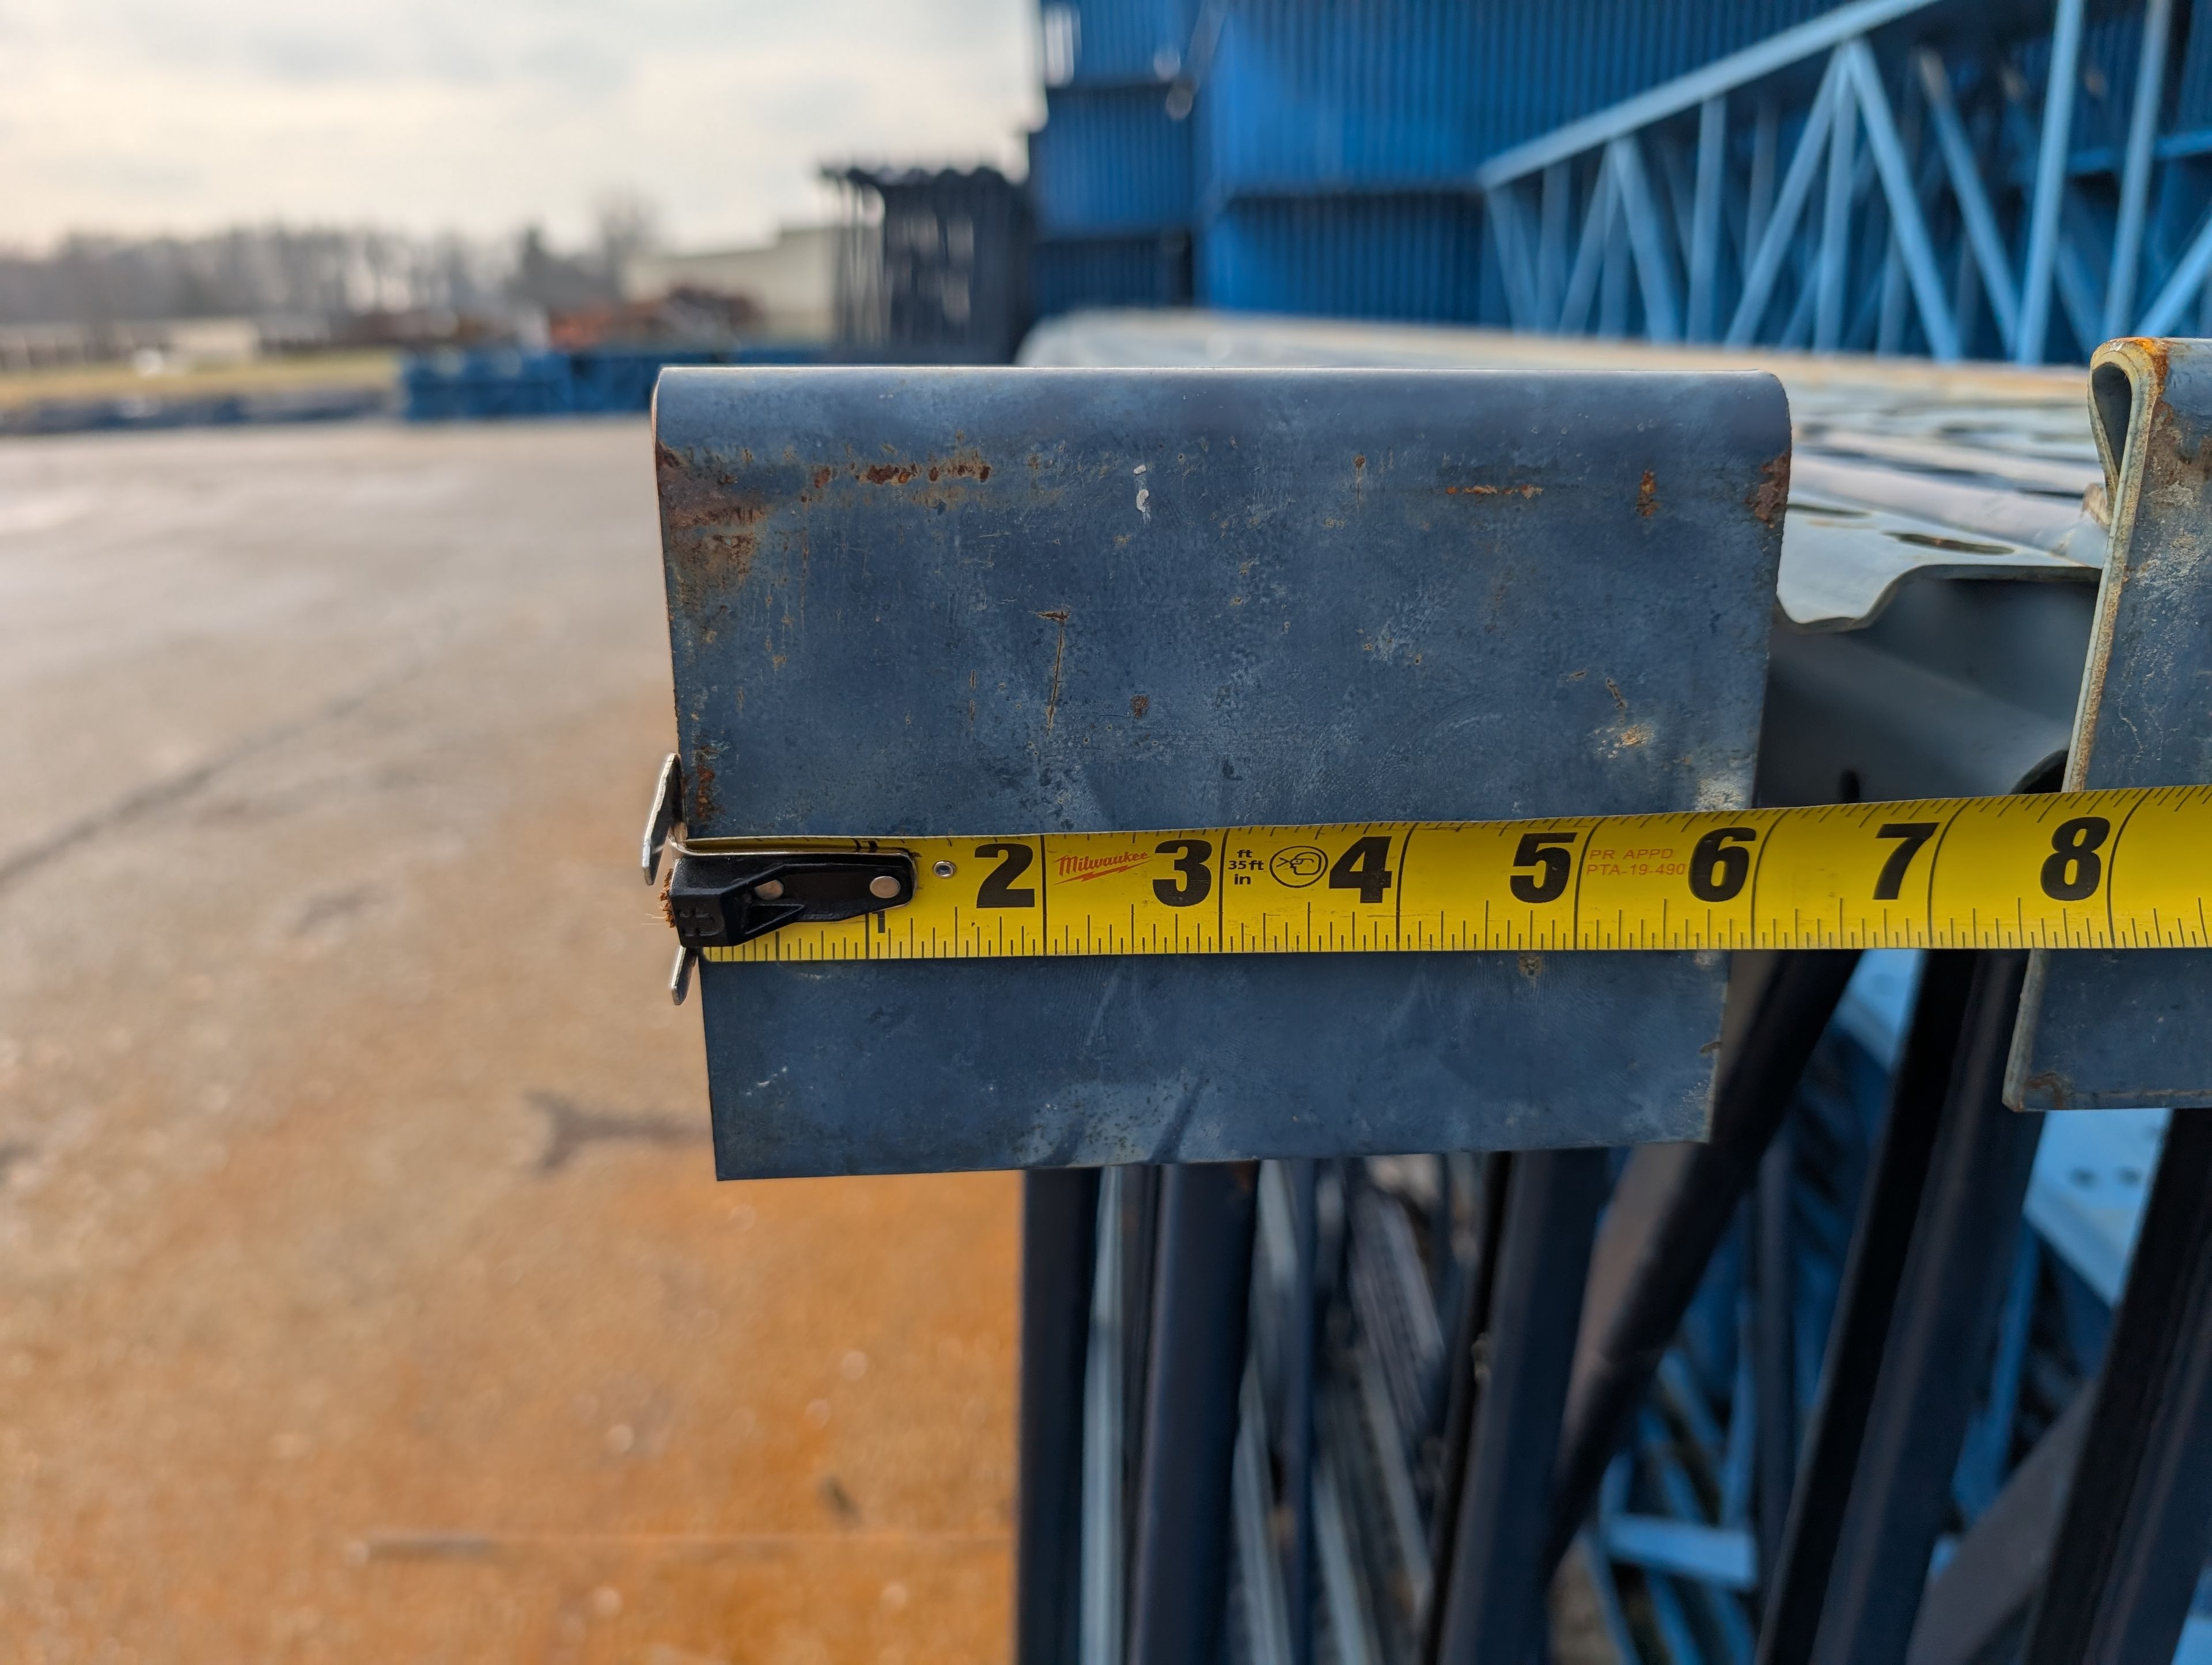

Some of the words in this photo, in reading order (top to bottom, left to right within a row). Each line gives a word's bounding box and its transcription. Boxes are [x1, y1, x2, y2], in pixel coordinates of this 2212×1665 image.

[974, 843, 1035, 908] 2
[1052, 851, 1151, 877] Milwaukee
[1152, 839, 1213, 907] 3
[1234, 873, 1251, 885] in
[1237, 849, 1253, 858] ft
[1328, 836, 1393, 904] 4
[1509, 832, 1578, 904] 5
[1586, 863, 1685, 875] PTA-19-490
[1589, 849, 1615, 860] PR
[1623, 848, 1674, 859] APPD
[1688, 827, 1757, 902] 6
[1872, 822, 1940, 900] 7
[2040, 817, 2110, 901] 8
